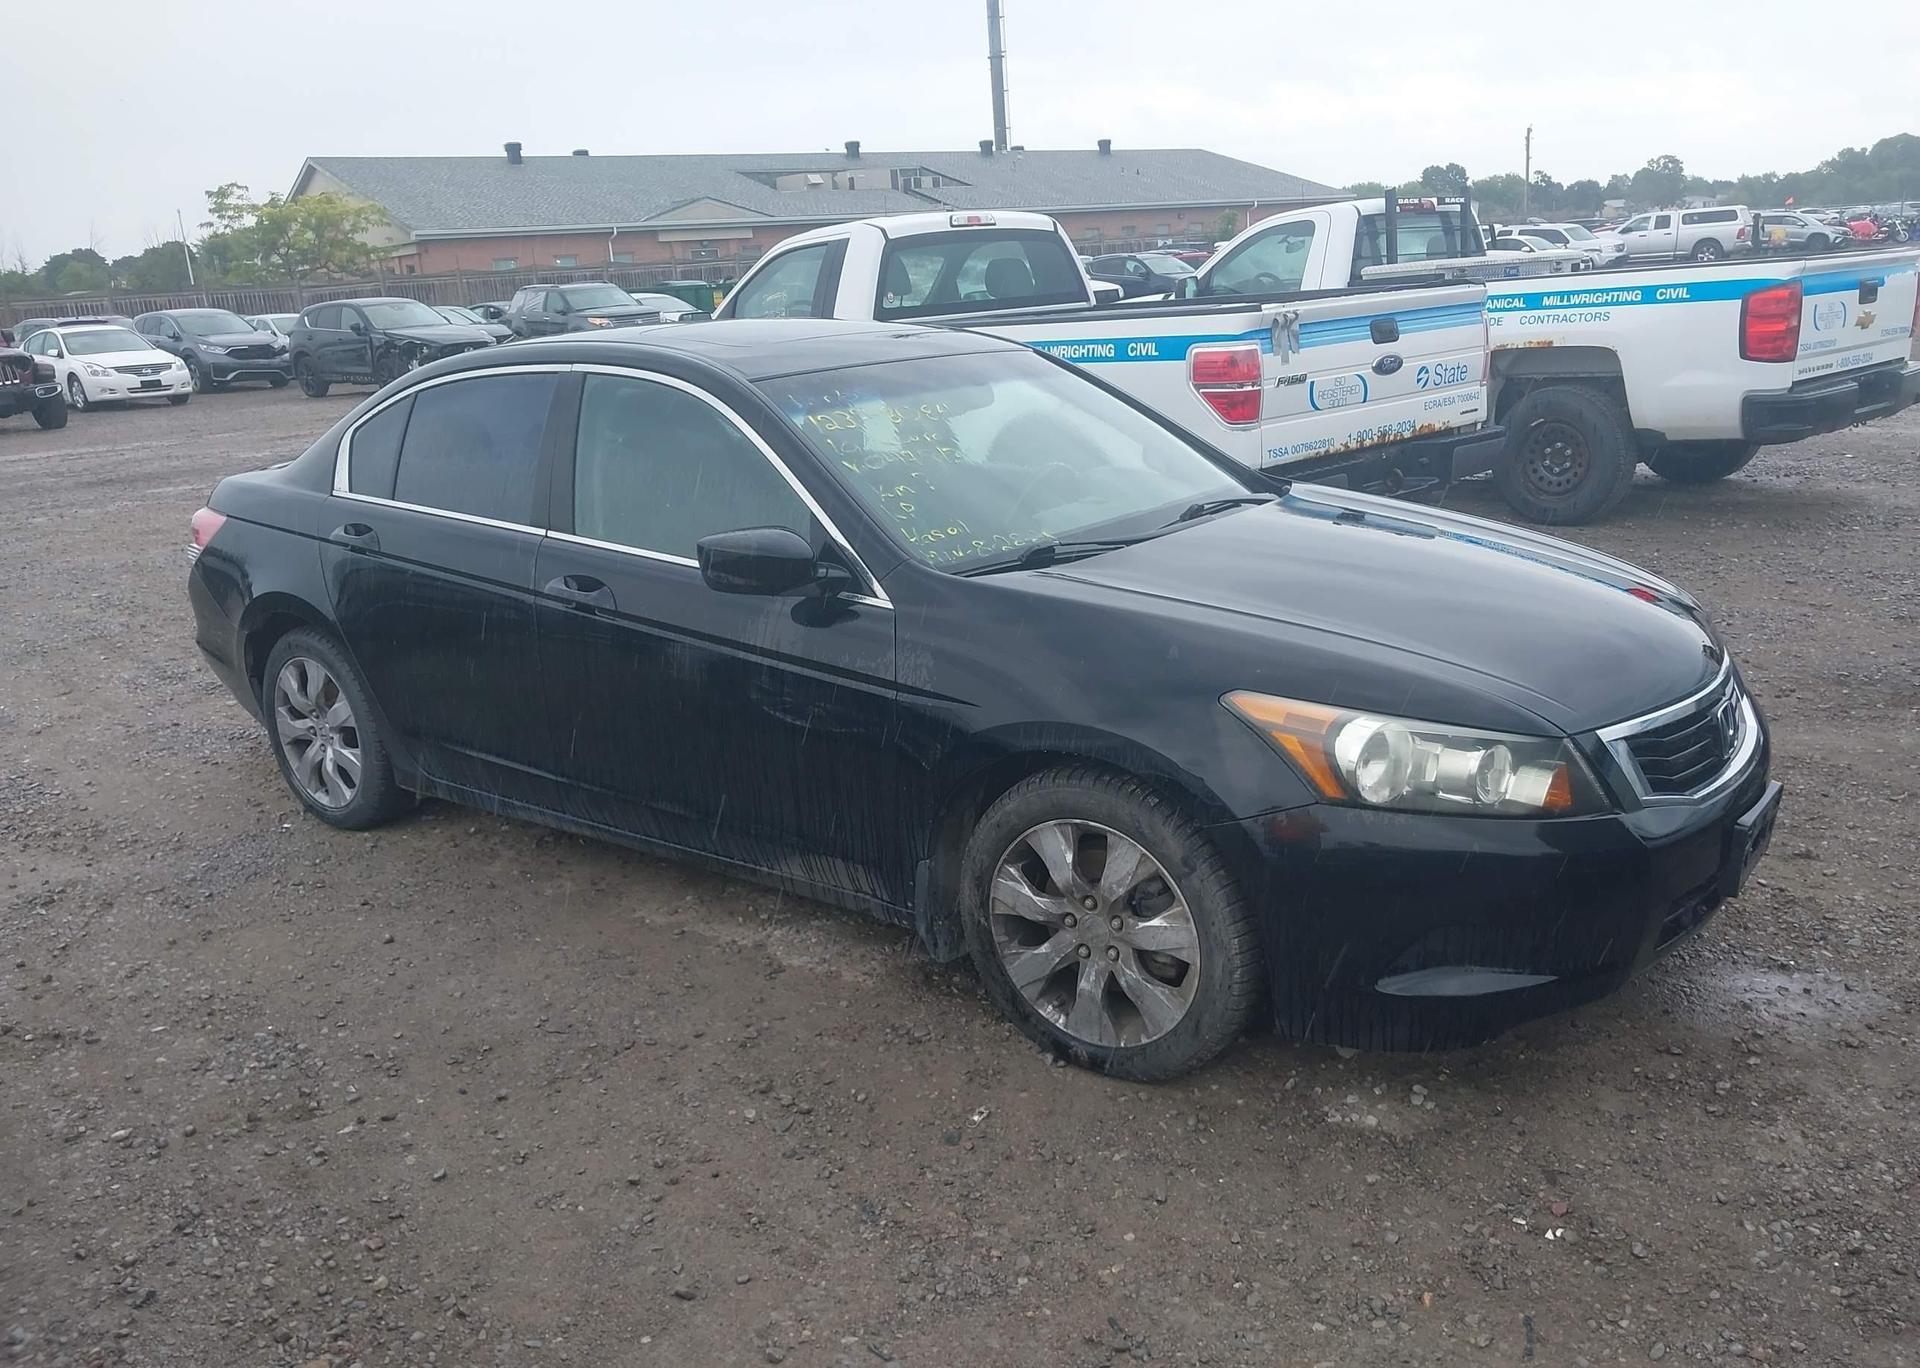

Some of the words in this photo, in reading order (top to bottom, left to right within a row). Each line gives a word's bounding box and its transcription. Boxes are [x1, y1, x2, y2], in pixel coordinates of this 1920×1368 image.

[1486, 297, 1526, 309] ANICAL
[1542, 291, 1642, 307] MILLWRIGHTING
[1656, 287, 1691, 300] CIVIL
[1489, 316, 1505, 327] DE
[1519, 312, 1611, 326] CONTRACTORS
[1127, 342, 1159, 357] CIVIL
[1274, 374, 1307, 388] F-150
[1432, 363, 1468, 386] State
[1318, 384, 1360, 400] REGISTERED
[1328, 397, 1347, 408] 9001
[1267, 446, 1289, 459] TSSA
[1290, 438, 1335, 455] 0076622810
